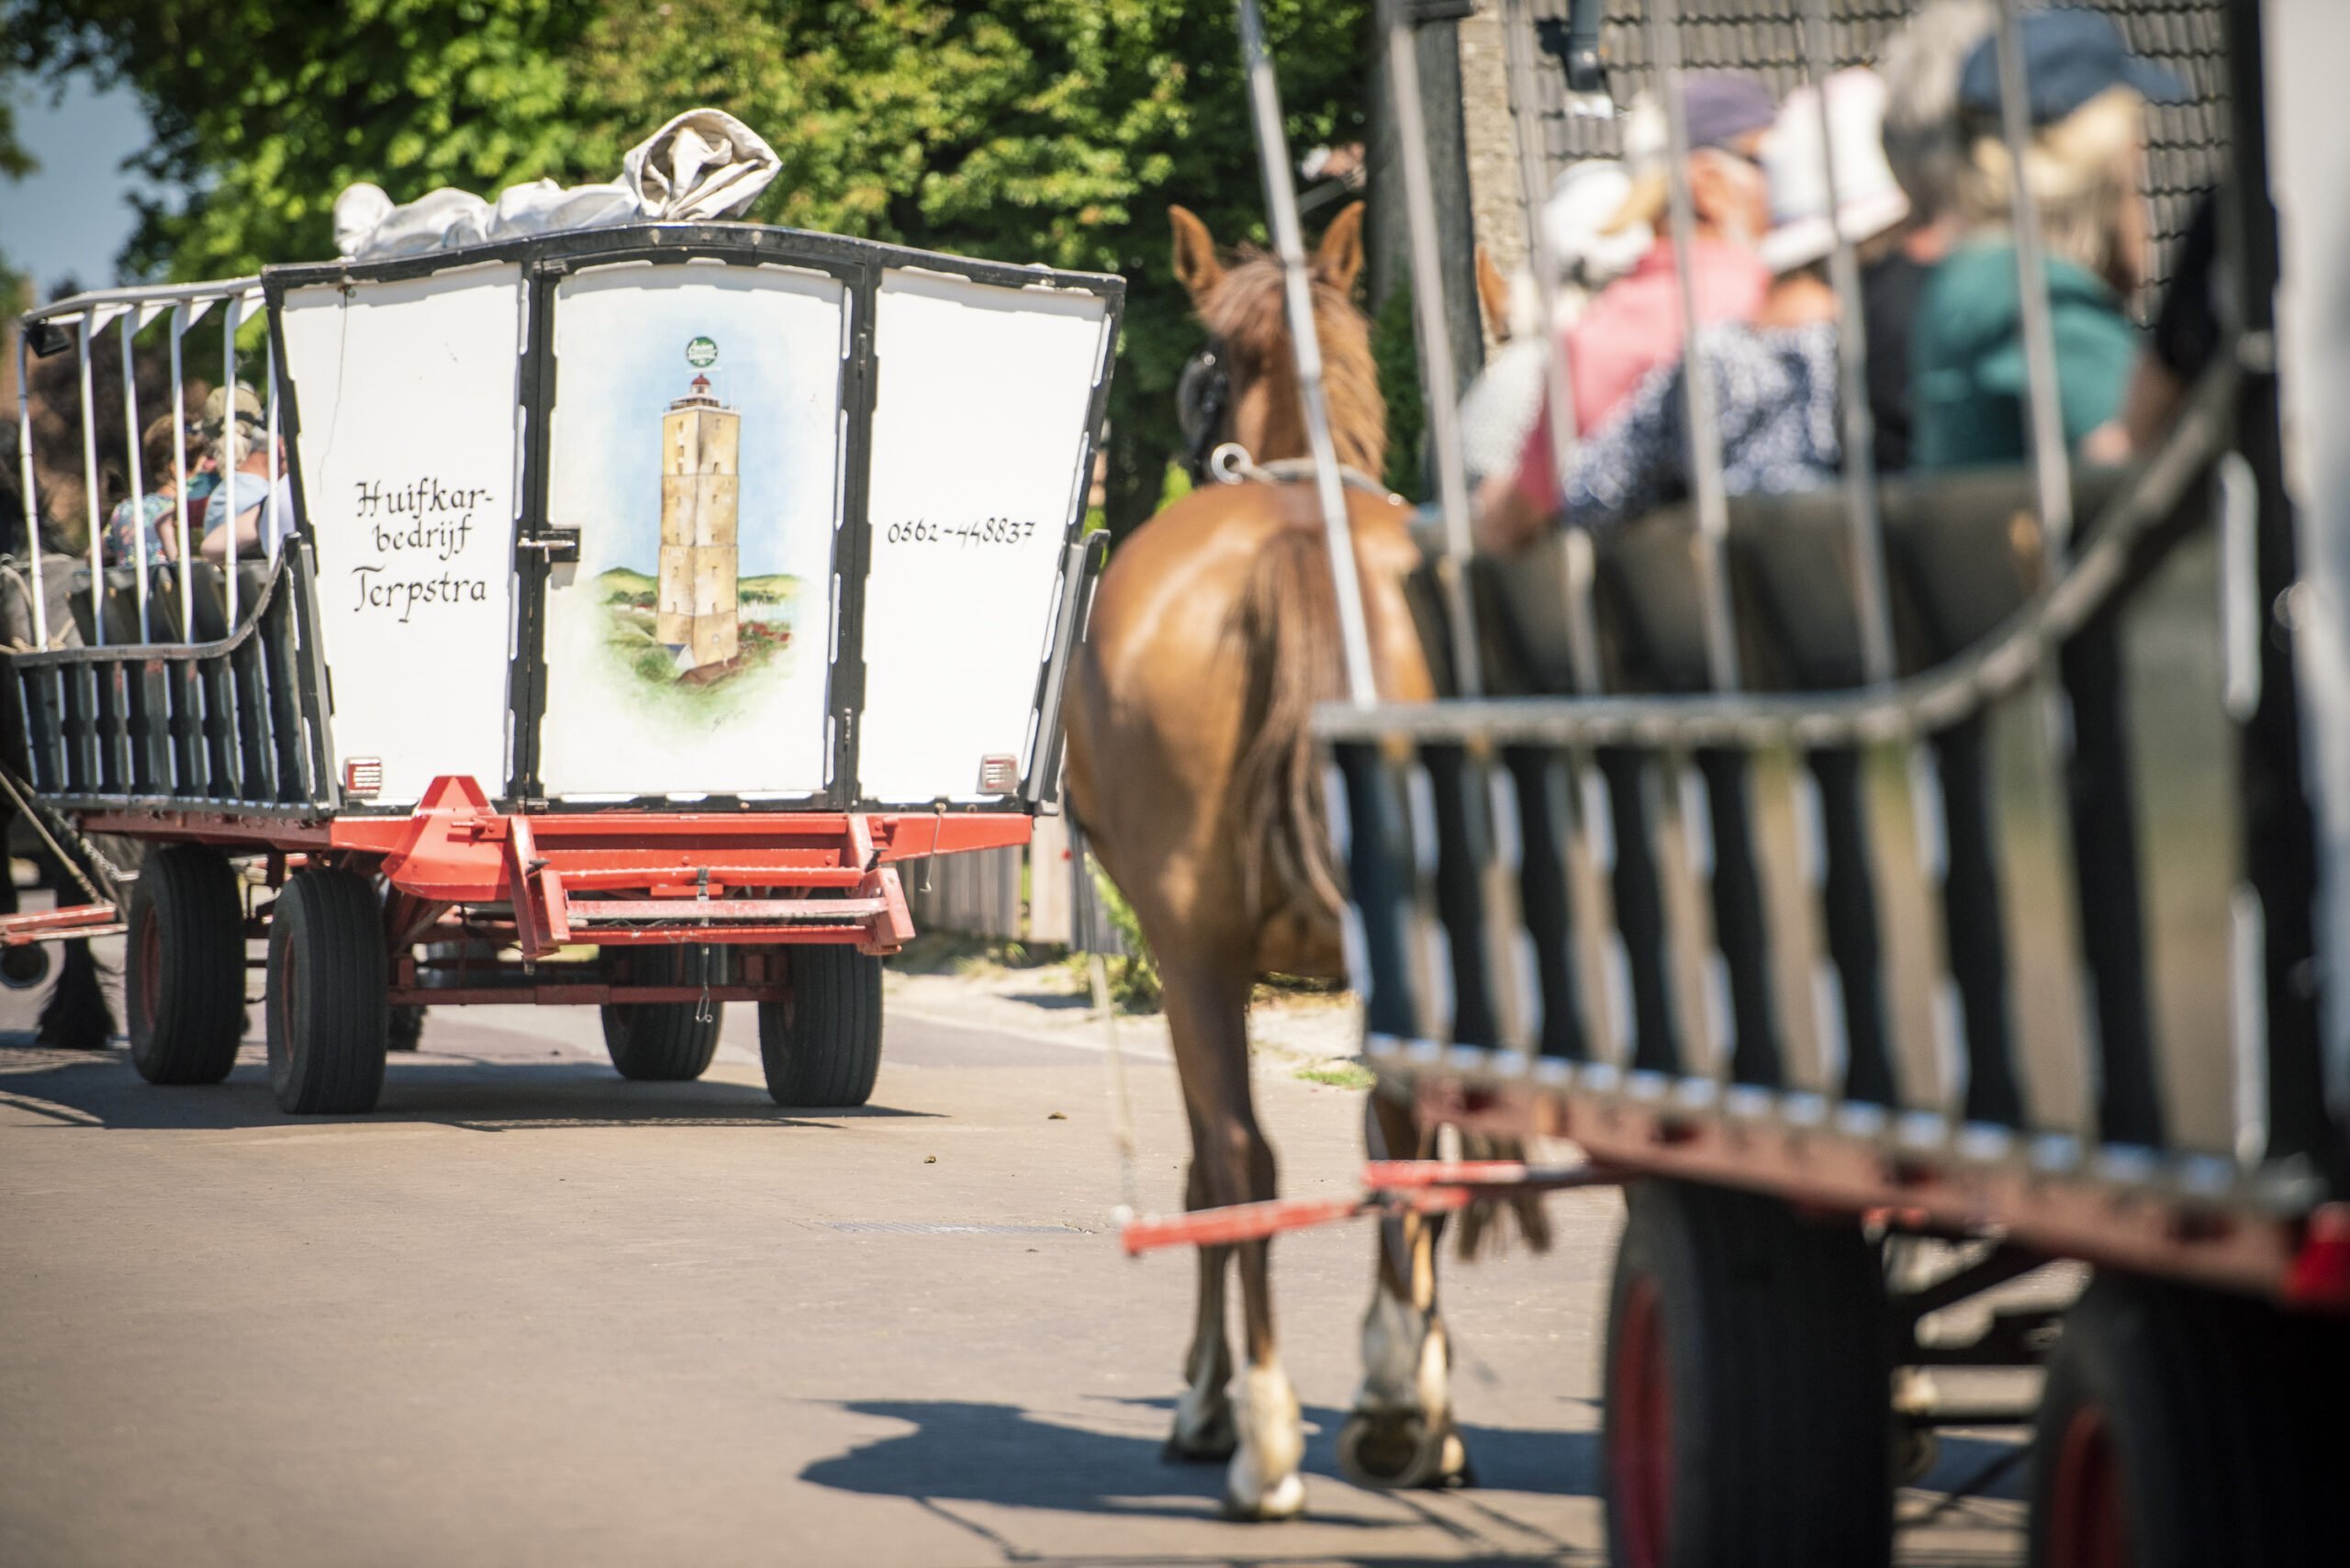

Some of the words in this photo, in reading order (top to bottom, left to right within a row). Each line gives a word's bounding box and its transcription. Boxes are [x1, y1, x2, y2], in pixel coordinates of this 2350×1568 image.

[354, 476, 494, 519] Huifkar-
[373, 513, 473, 561] bedrijf
[888, 517, 1035, 549] 0562-448837
[352, 565, 487, 623] Terpstra
